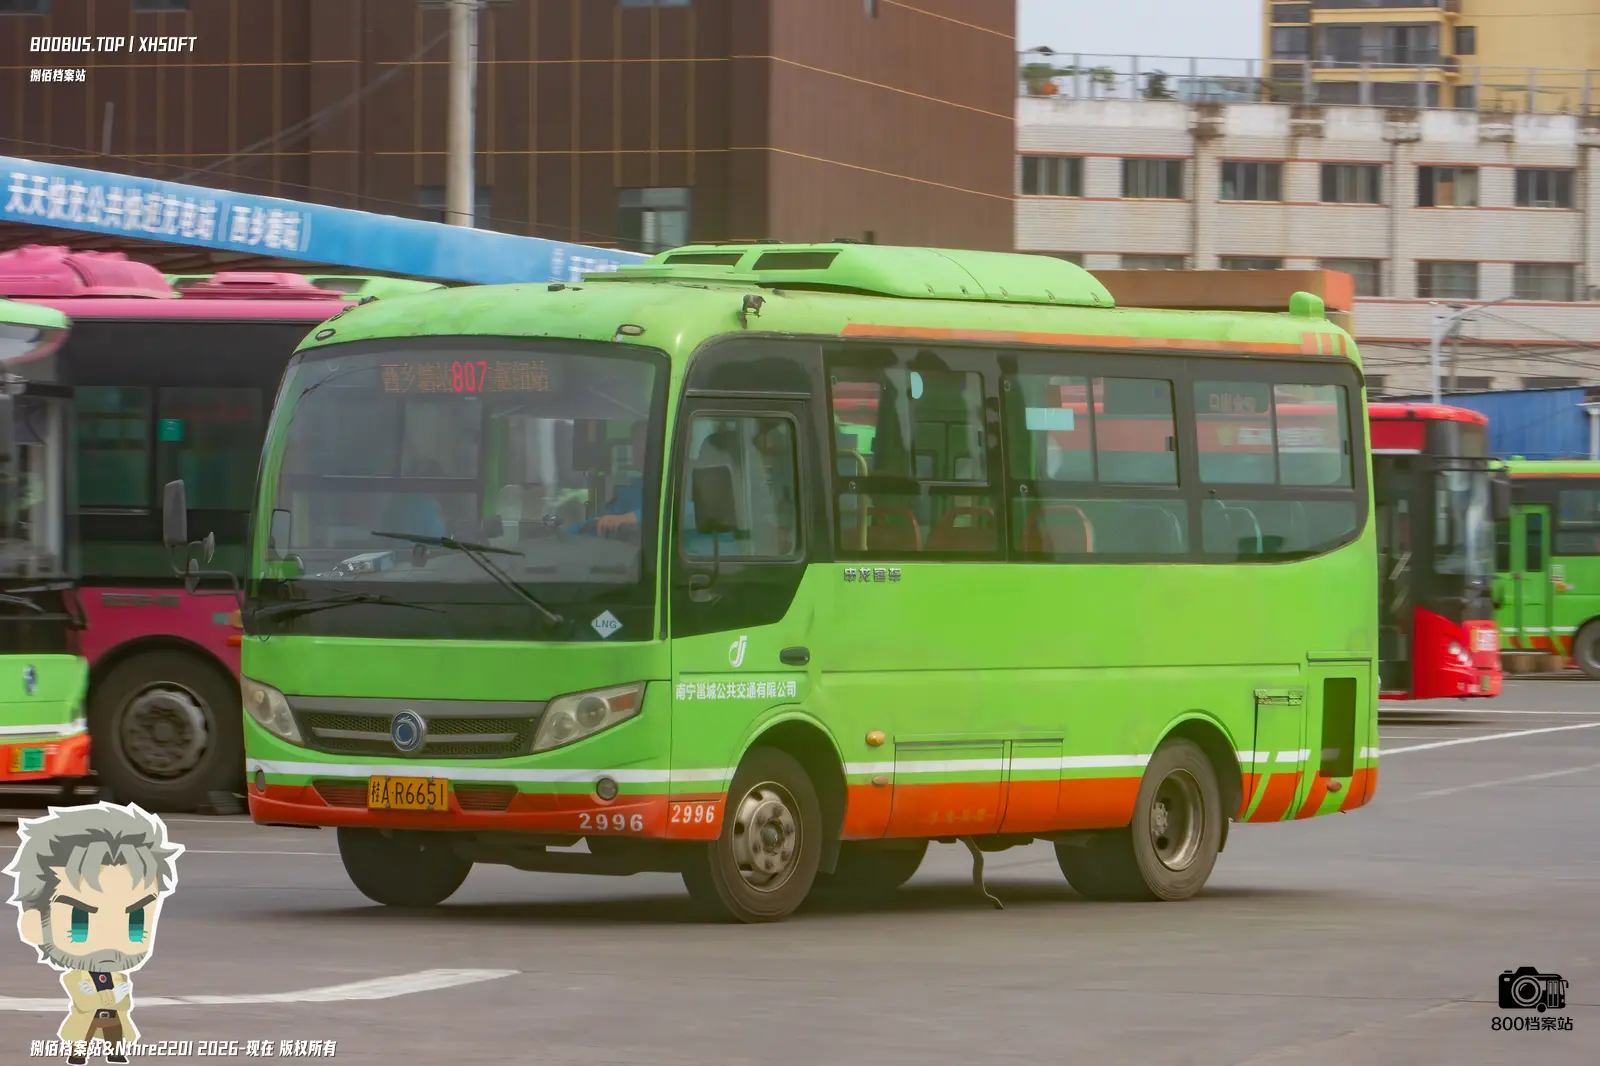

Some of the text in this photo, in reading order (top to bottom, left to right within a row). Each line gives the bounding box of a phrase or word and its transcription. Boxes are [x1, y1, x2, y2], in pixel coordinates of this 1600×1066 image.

[451, 361, 487, 393] 807
[843, 567, 902, 583] 申龙客车
[594, 619, 617, 630] LNG
[675, 680, 797, 701] 南宁邕城公共交通有限公司
[578, 812, 644, 832] 2996
[670, 804, 715, 825] 2996
